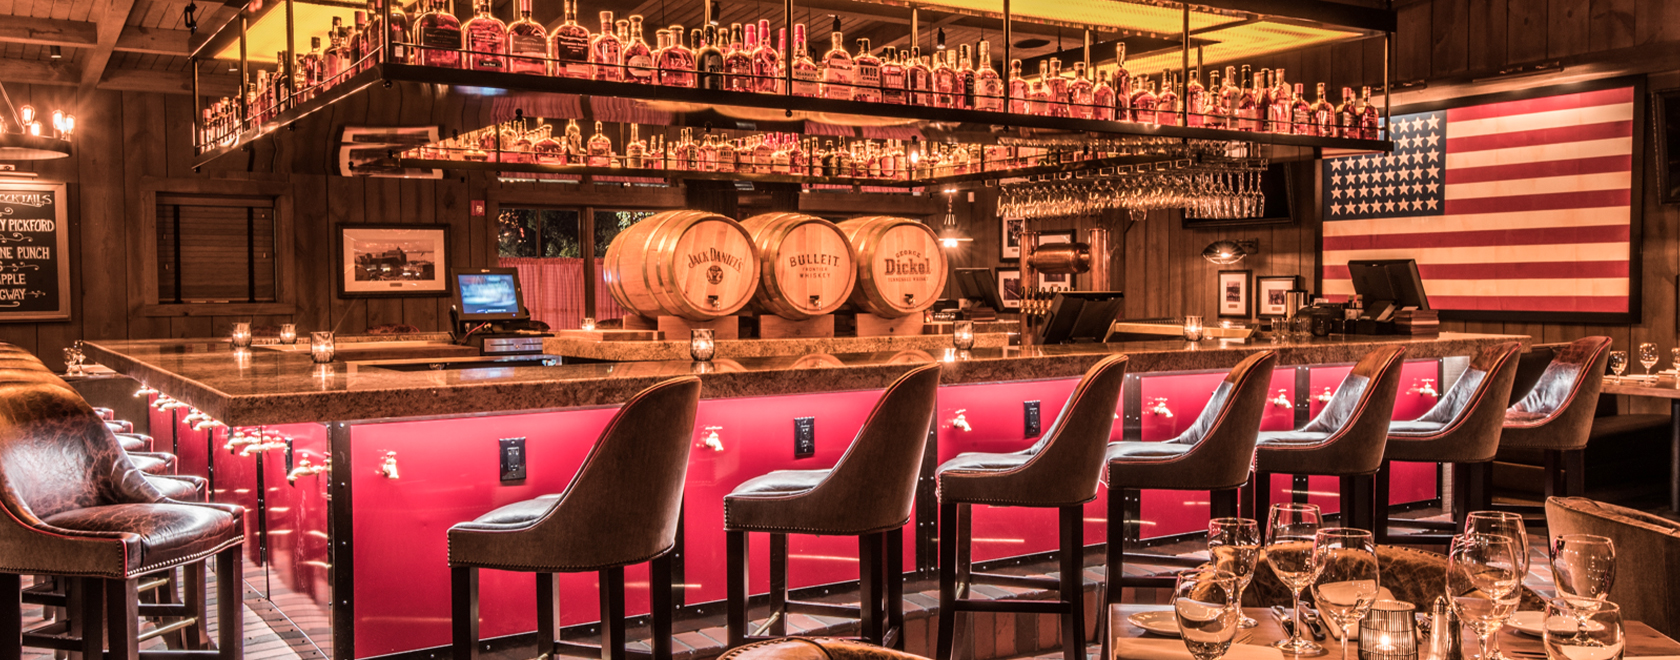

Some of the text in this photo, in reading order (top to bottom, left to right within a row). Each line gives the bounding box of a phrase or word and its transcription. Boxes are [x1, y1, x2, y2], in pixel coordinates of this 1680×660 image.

[861, 67, 877, 77] KNOB
[8, 218, 55, 232] PICKFORD
[17, 246, 50, 259] PUNCH
[895, 249, 921, 259] GEORGE
[688, 247, 744, 274] JACK DANIEL'S
[789, 254, 840, 267] BULLEIT
[884, 257, 931, 276] Dickel
